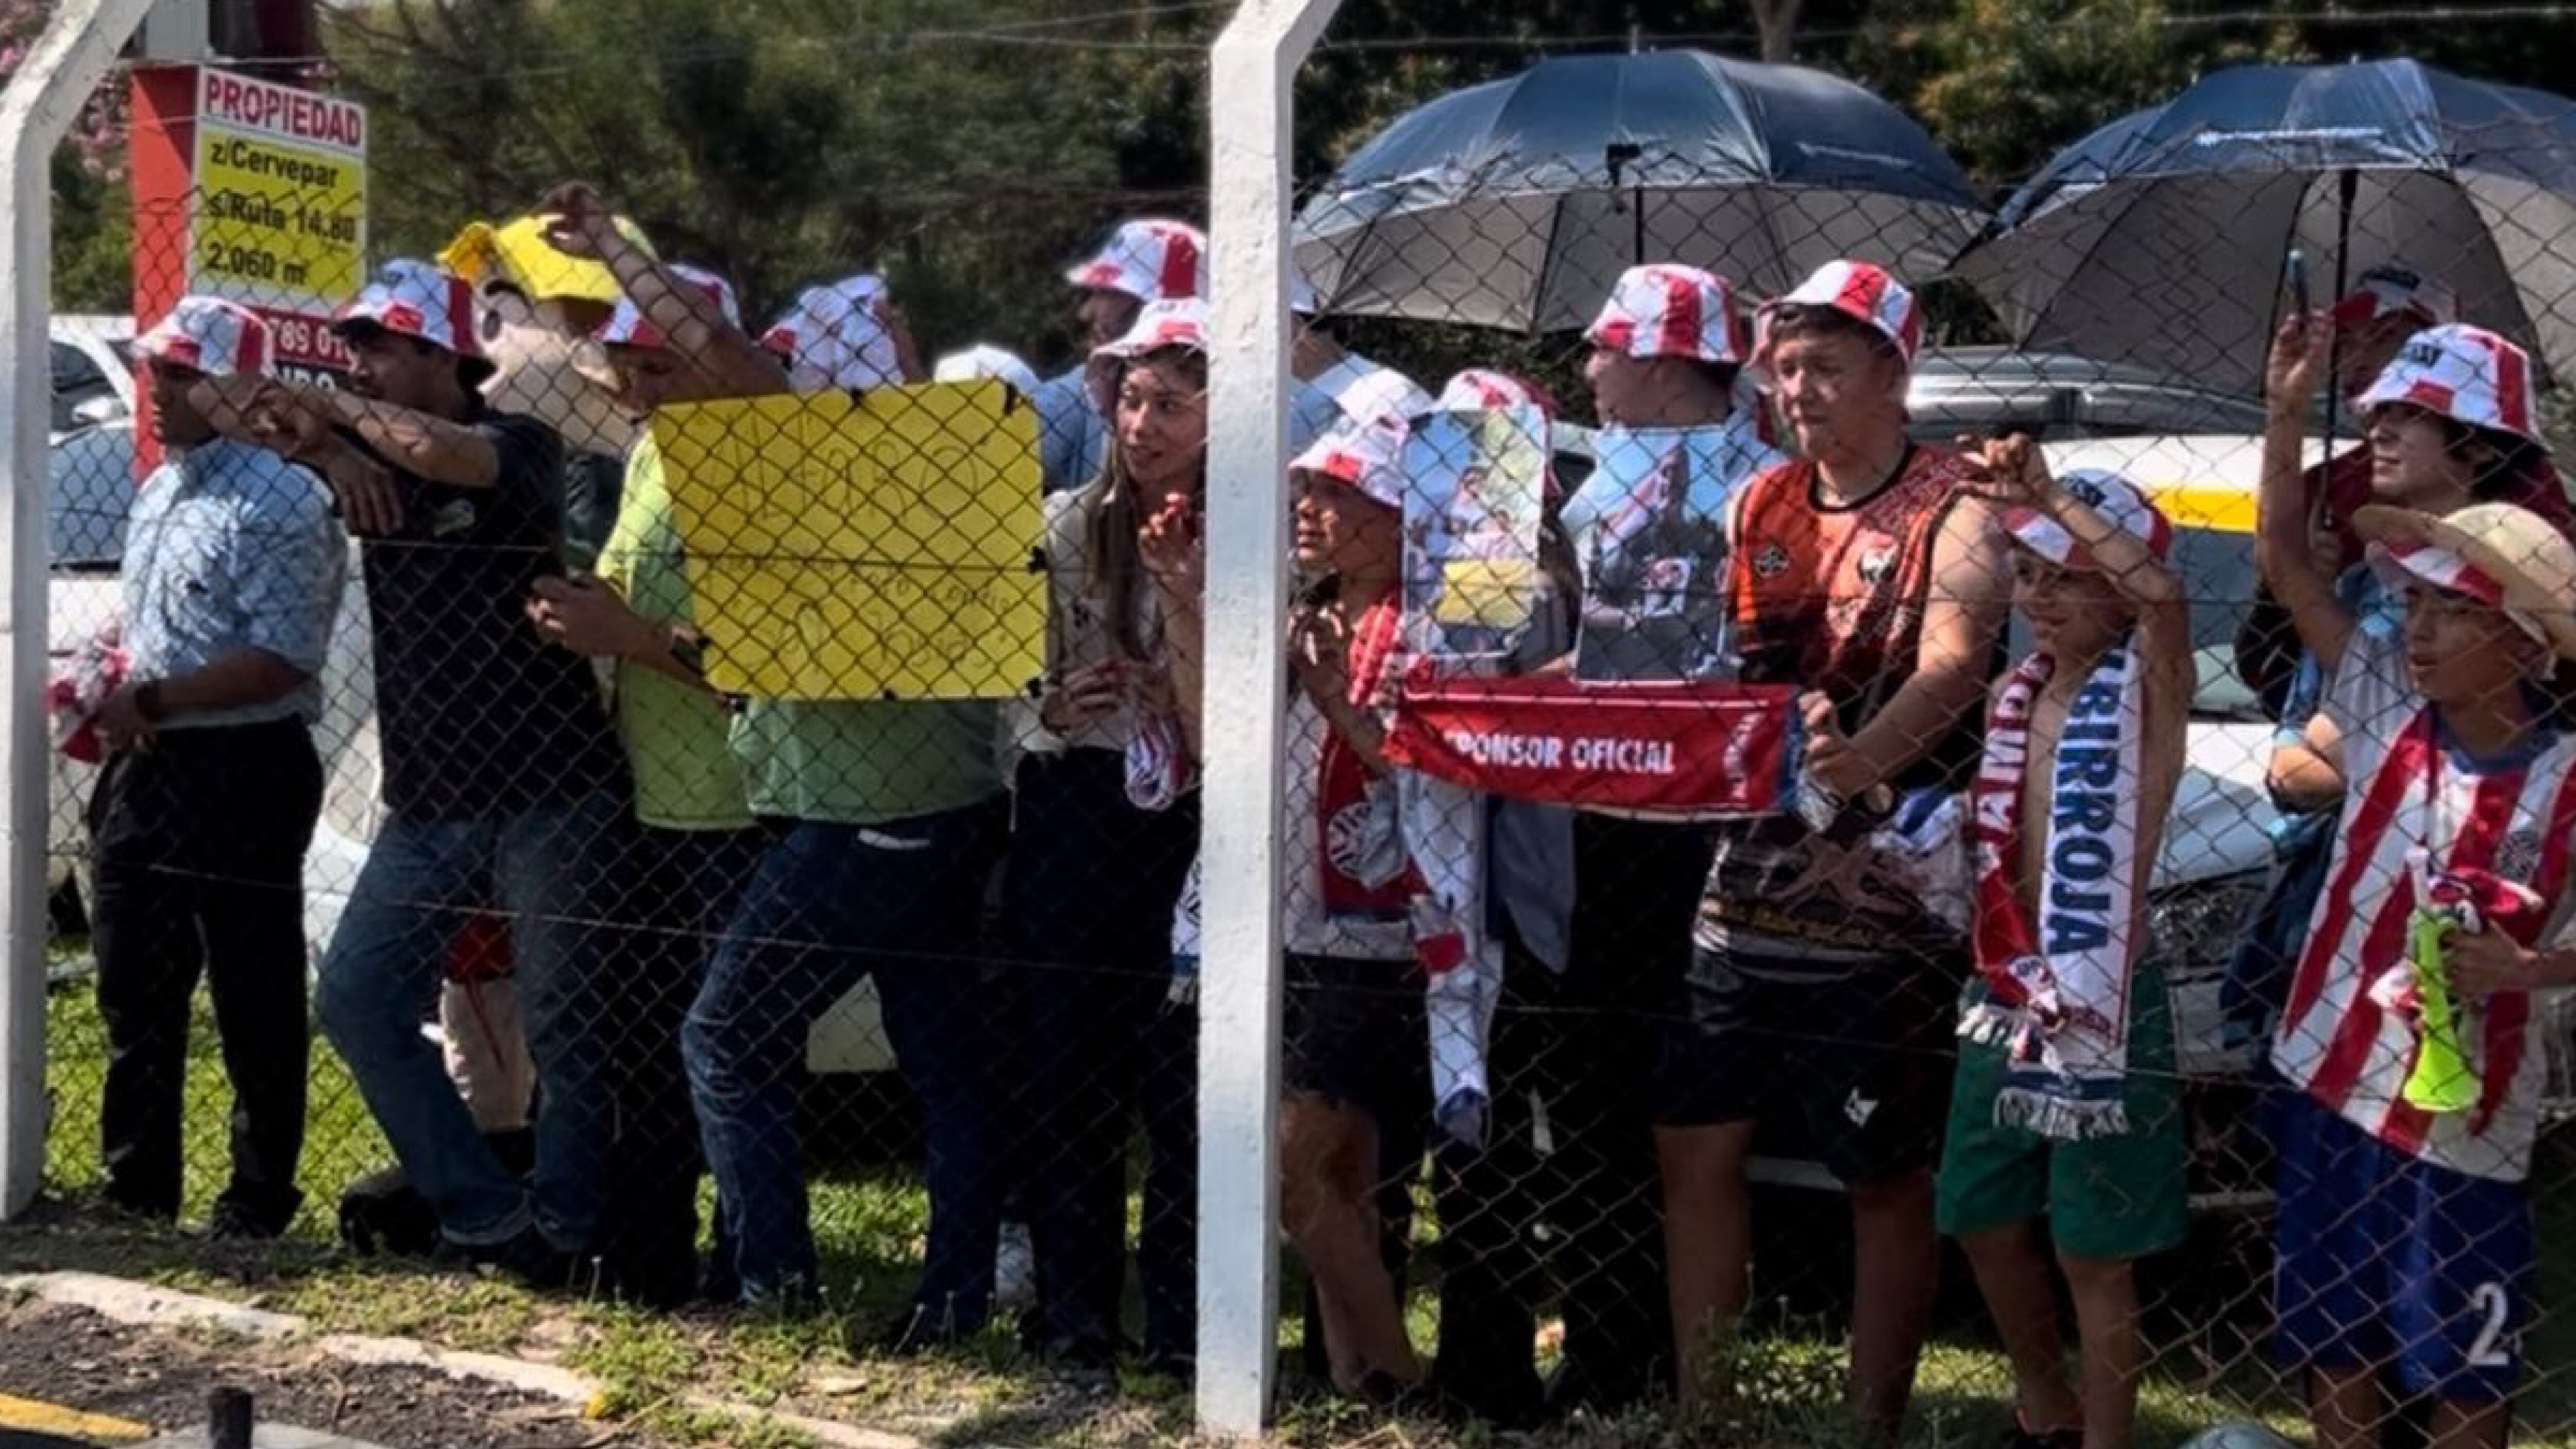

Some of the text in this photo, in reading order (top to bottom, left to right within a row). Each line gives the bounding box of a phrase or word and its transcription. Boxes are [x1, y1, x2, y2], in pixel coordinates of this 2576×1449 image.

[207, 74, 360, 147] PROPIEDAD
[210, 140, 337, 189] z/Cervepar
[207, 242, 275, 280] 2.060
[1570, 737, 1675, 773] OFICIAL
[2468, 1282, 2510, 1366] 2
